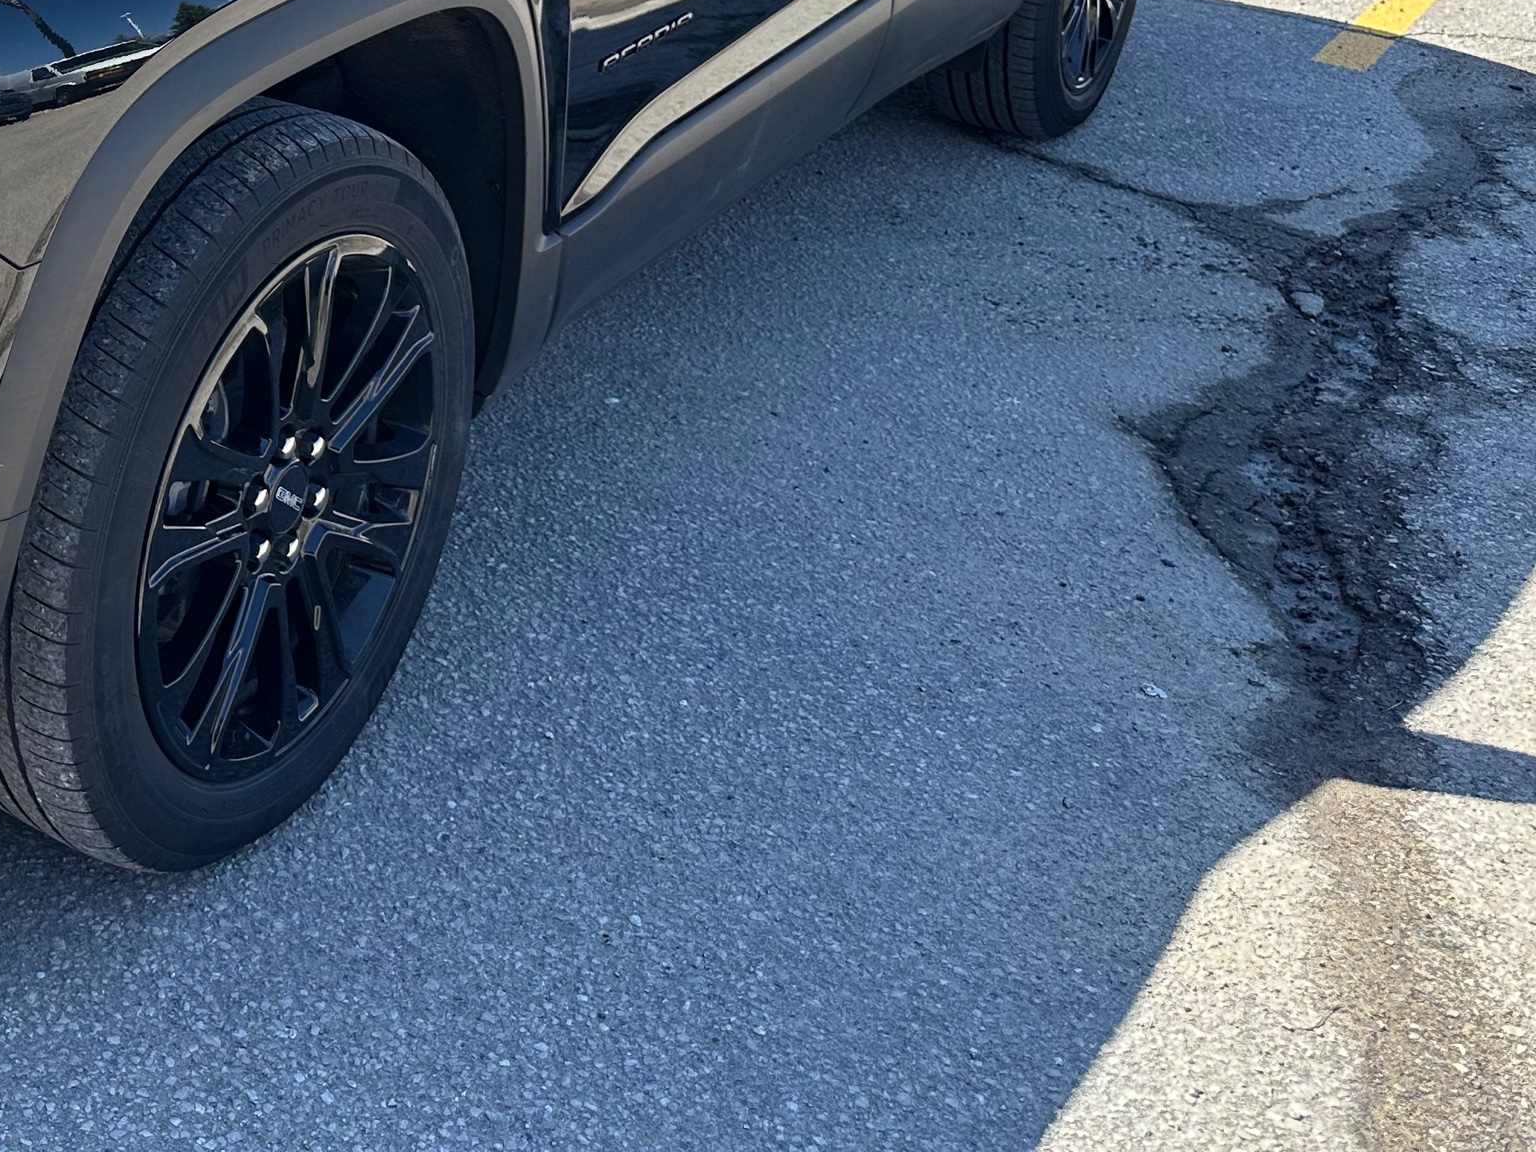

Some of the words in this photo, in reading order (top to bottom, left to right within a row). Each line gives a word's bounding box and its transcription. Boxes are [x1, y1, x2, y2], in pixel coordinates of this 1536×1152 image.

[263, 195, 326, 250] PRIMACY
[333, 180, 369, 204] TOUR
[275, 486, 304, 512] GMC
